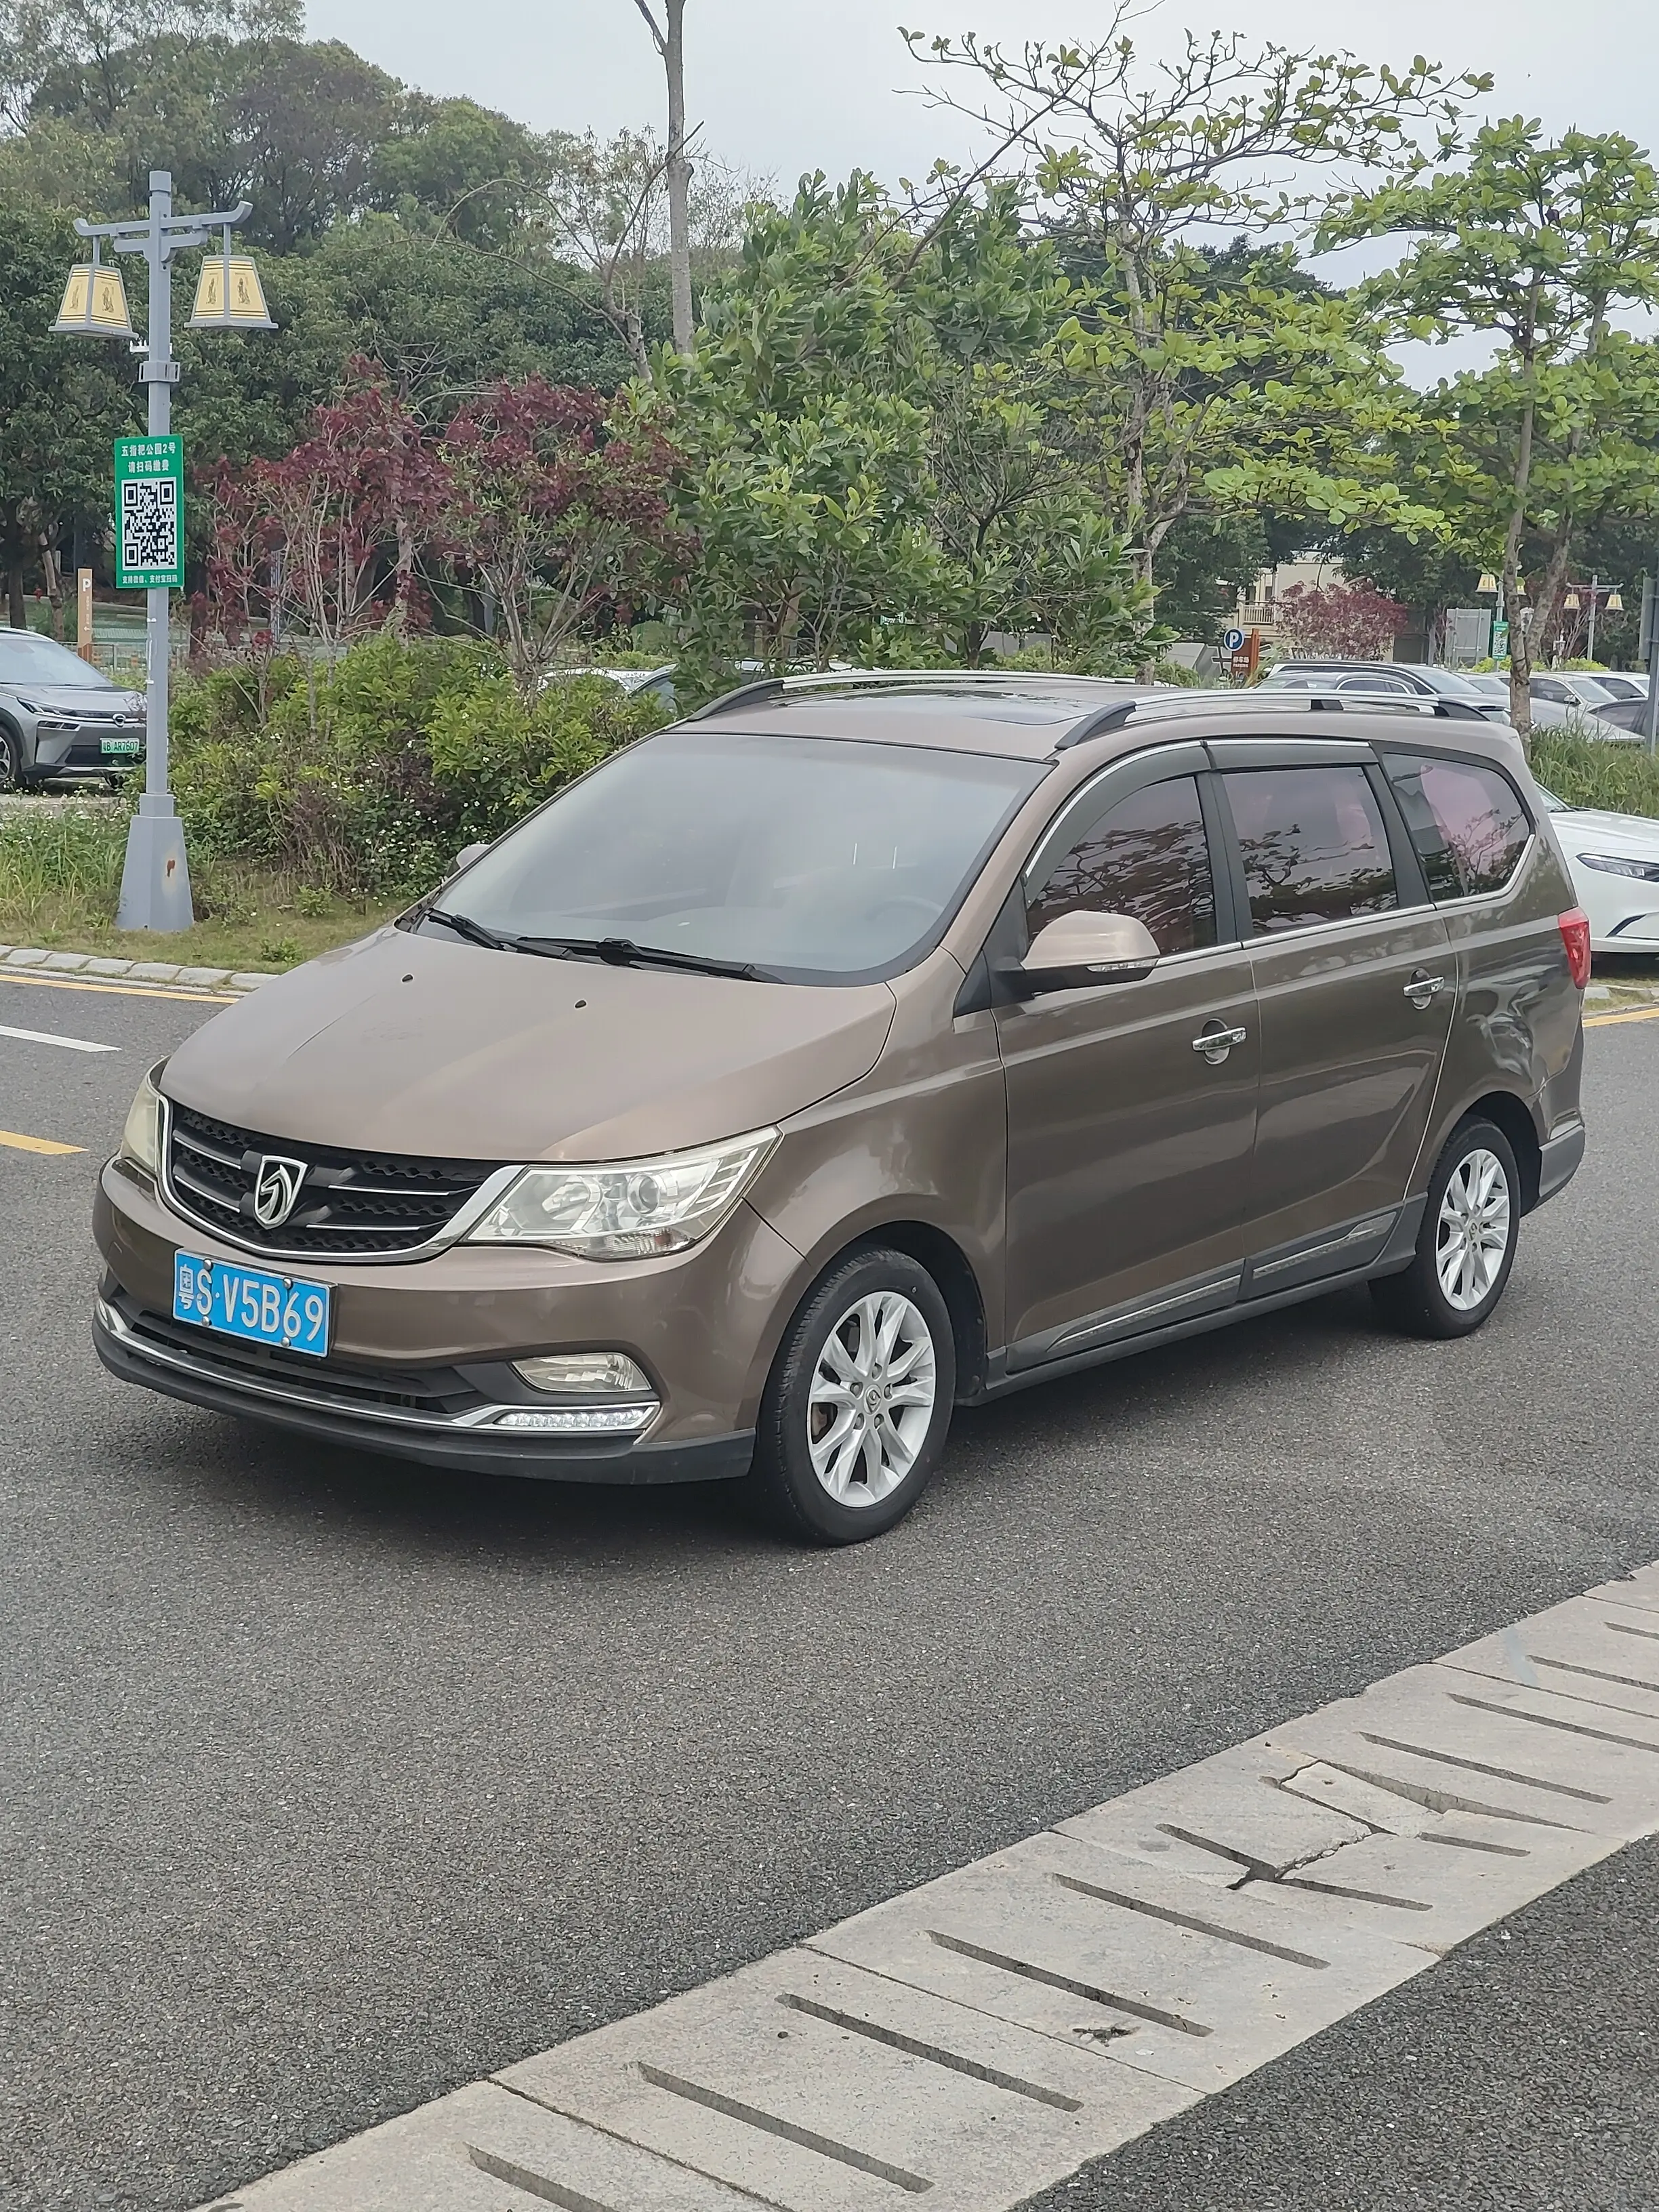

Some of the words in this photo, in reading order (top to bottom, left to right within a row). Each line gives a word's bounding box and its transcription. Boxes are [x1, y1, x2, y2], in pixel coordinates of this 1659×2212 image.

[128, 459, 169, 473] 请扫码缴费
[83, 578, 91, 592] P
[1229, 632, 1239, 648] P
